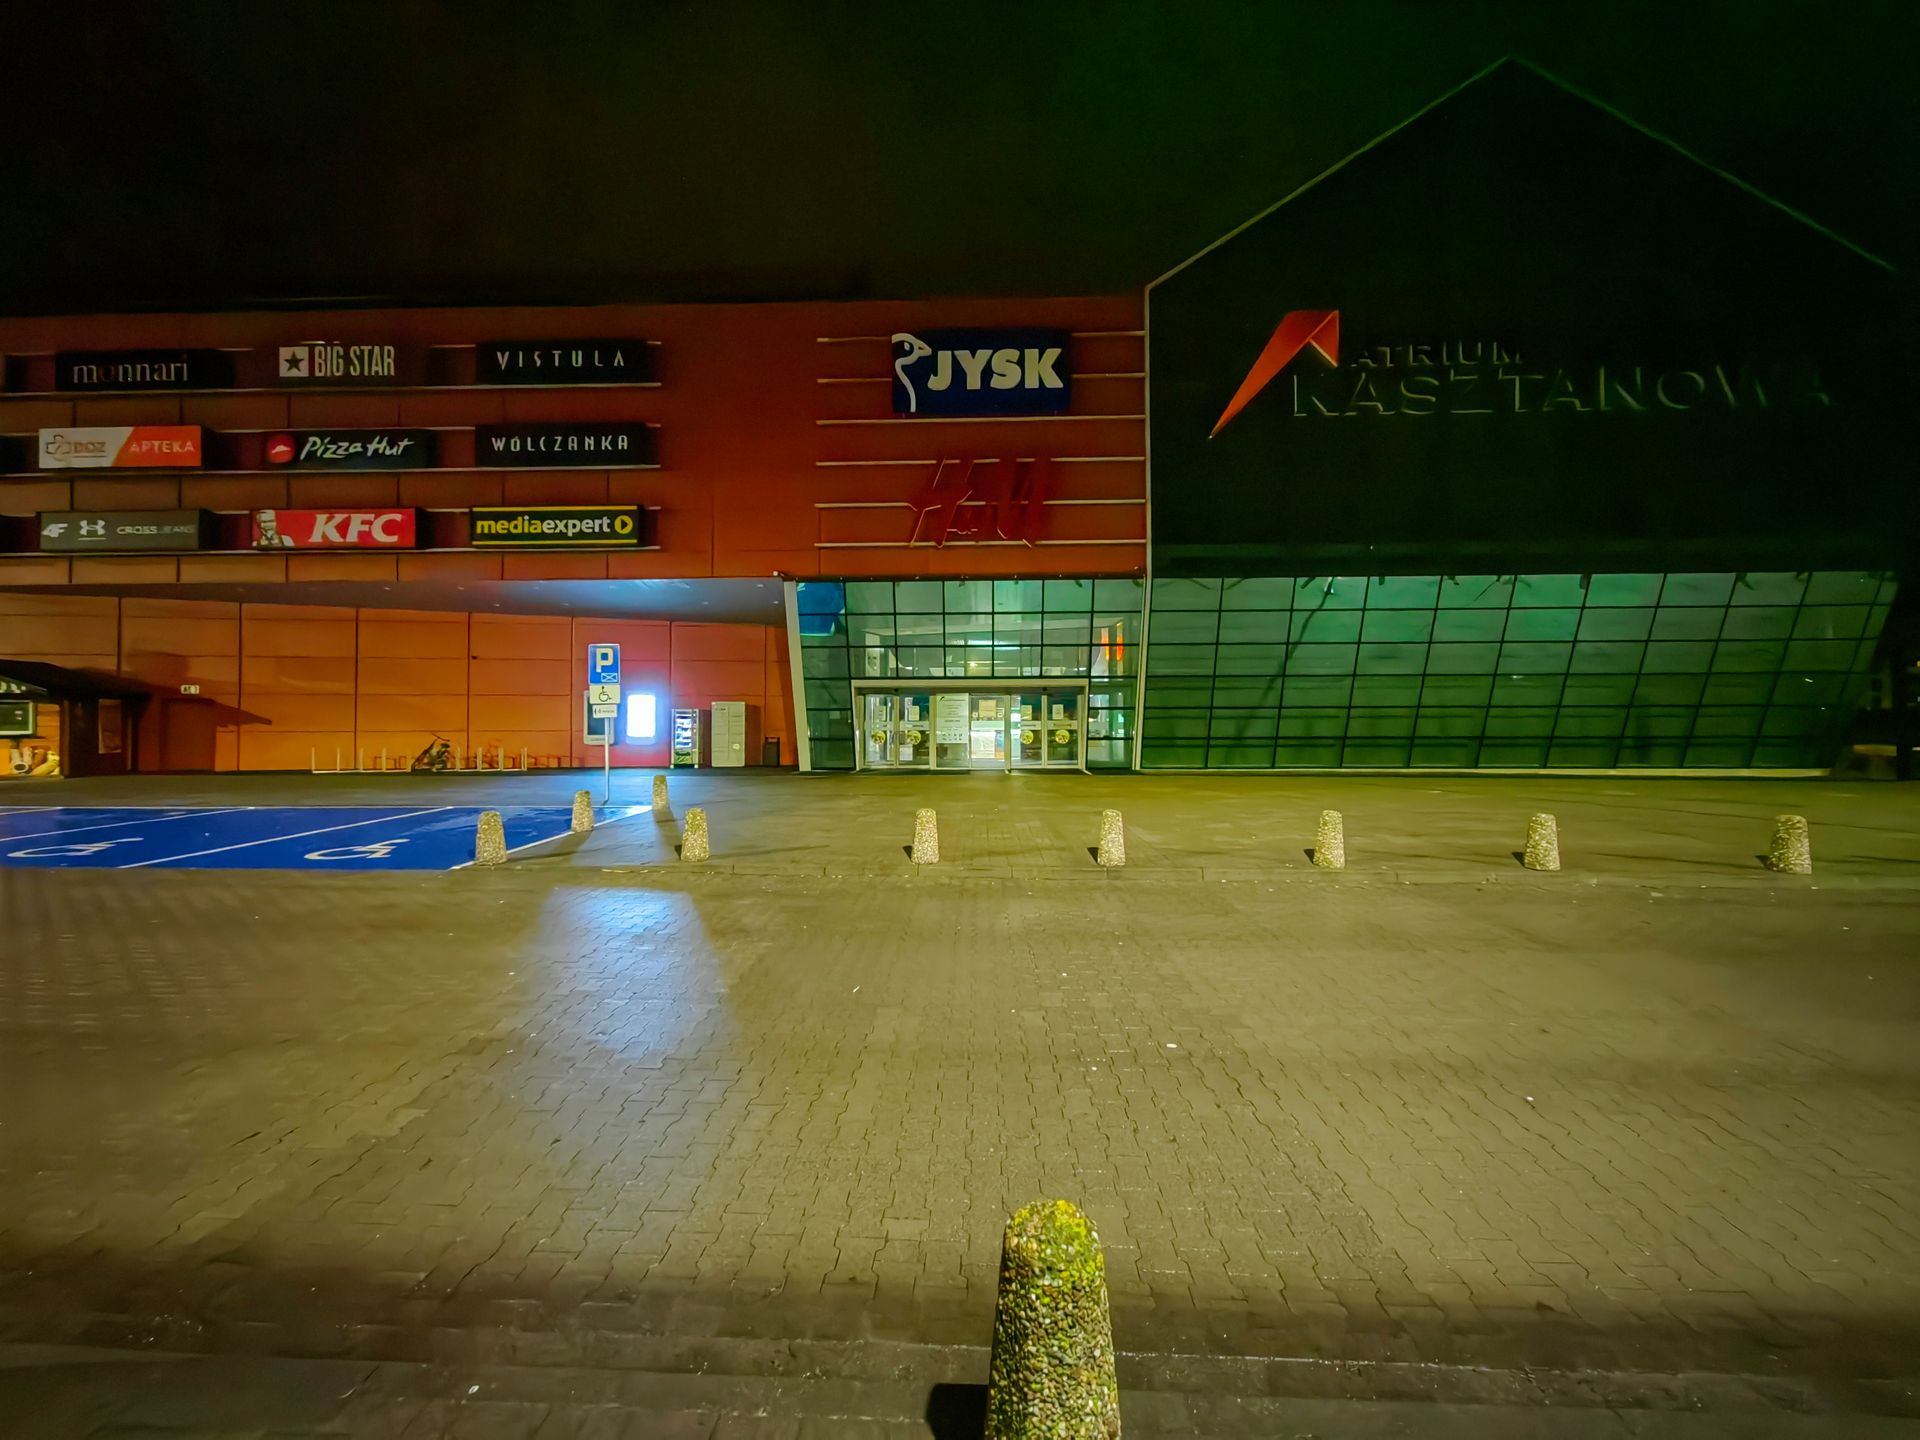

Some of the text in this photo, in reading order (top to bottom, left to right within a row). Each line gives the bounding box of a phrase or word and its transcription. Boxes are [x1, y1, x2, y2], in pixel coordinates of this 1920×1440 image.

[314, 345, 395, 377] BIG STAR
[496, 349, 625, 371] VISTULA
[1351, 341, 1523, 367] ATRIUM
[72, 353, 189, 384] monnari
[927, 348, 1064, 391] JYSK
[129, 440, 196, 454] APTEKA
[299, 435, 416, 461] Pizza Hut
[116, 525, 158, 535] CROSS
[308, 513, 403, 543] KFC
[476, 515, 611, 537] mediaexpert
[595, 648, 614, 673] P
